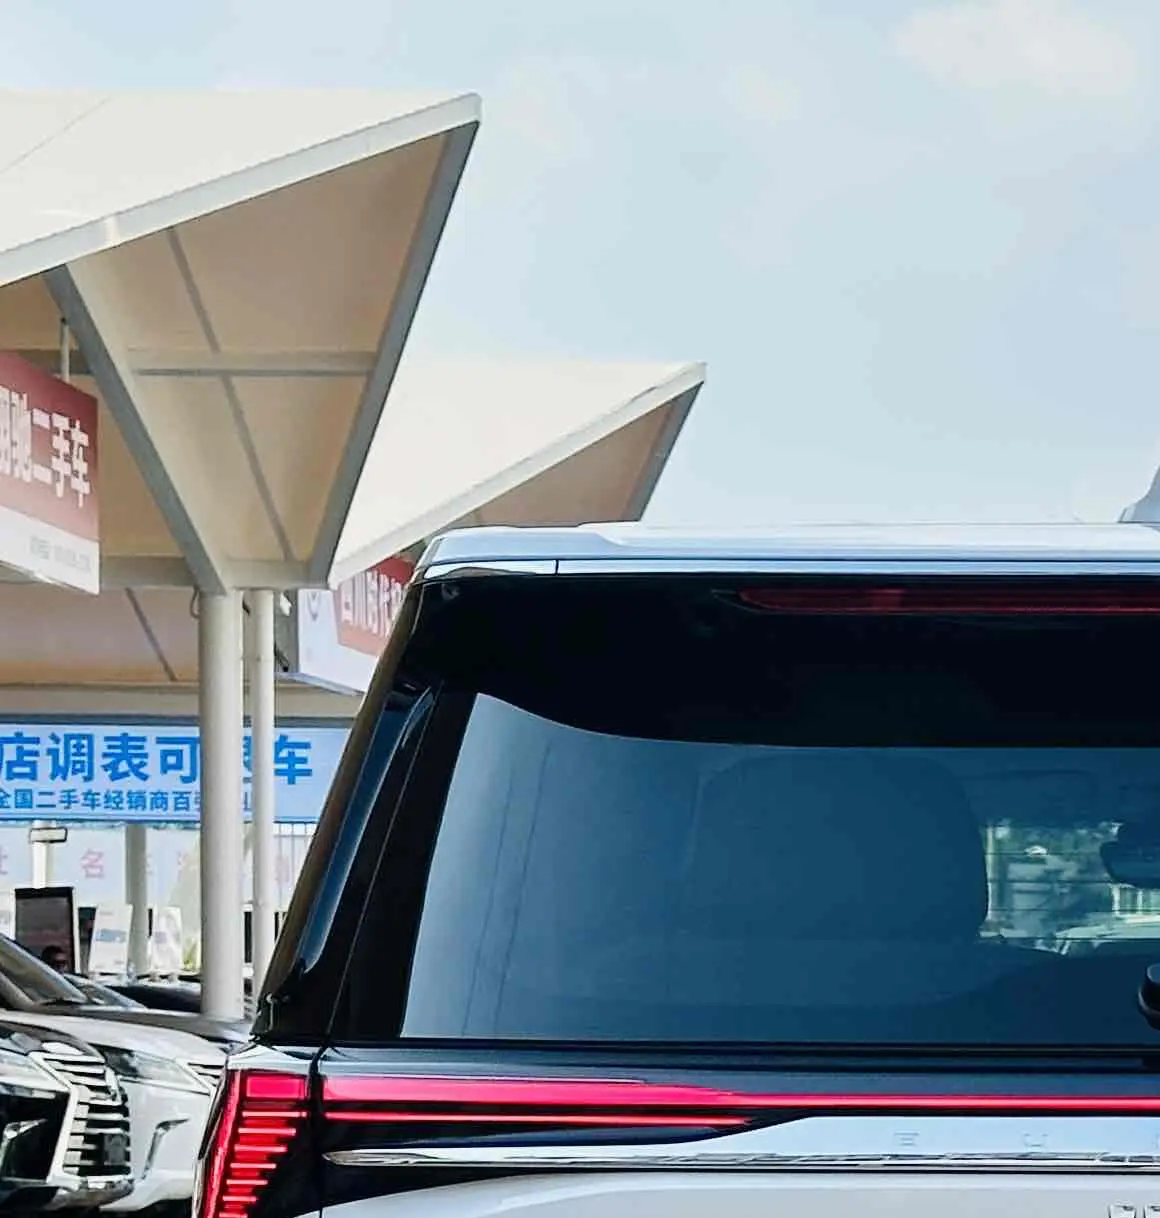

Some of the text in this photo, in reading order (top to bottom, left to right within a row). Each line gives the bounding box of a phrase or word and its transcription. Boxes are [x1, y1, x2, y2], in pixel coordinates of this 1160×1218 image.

[0, 732, 313, 785] 店调表可车
